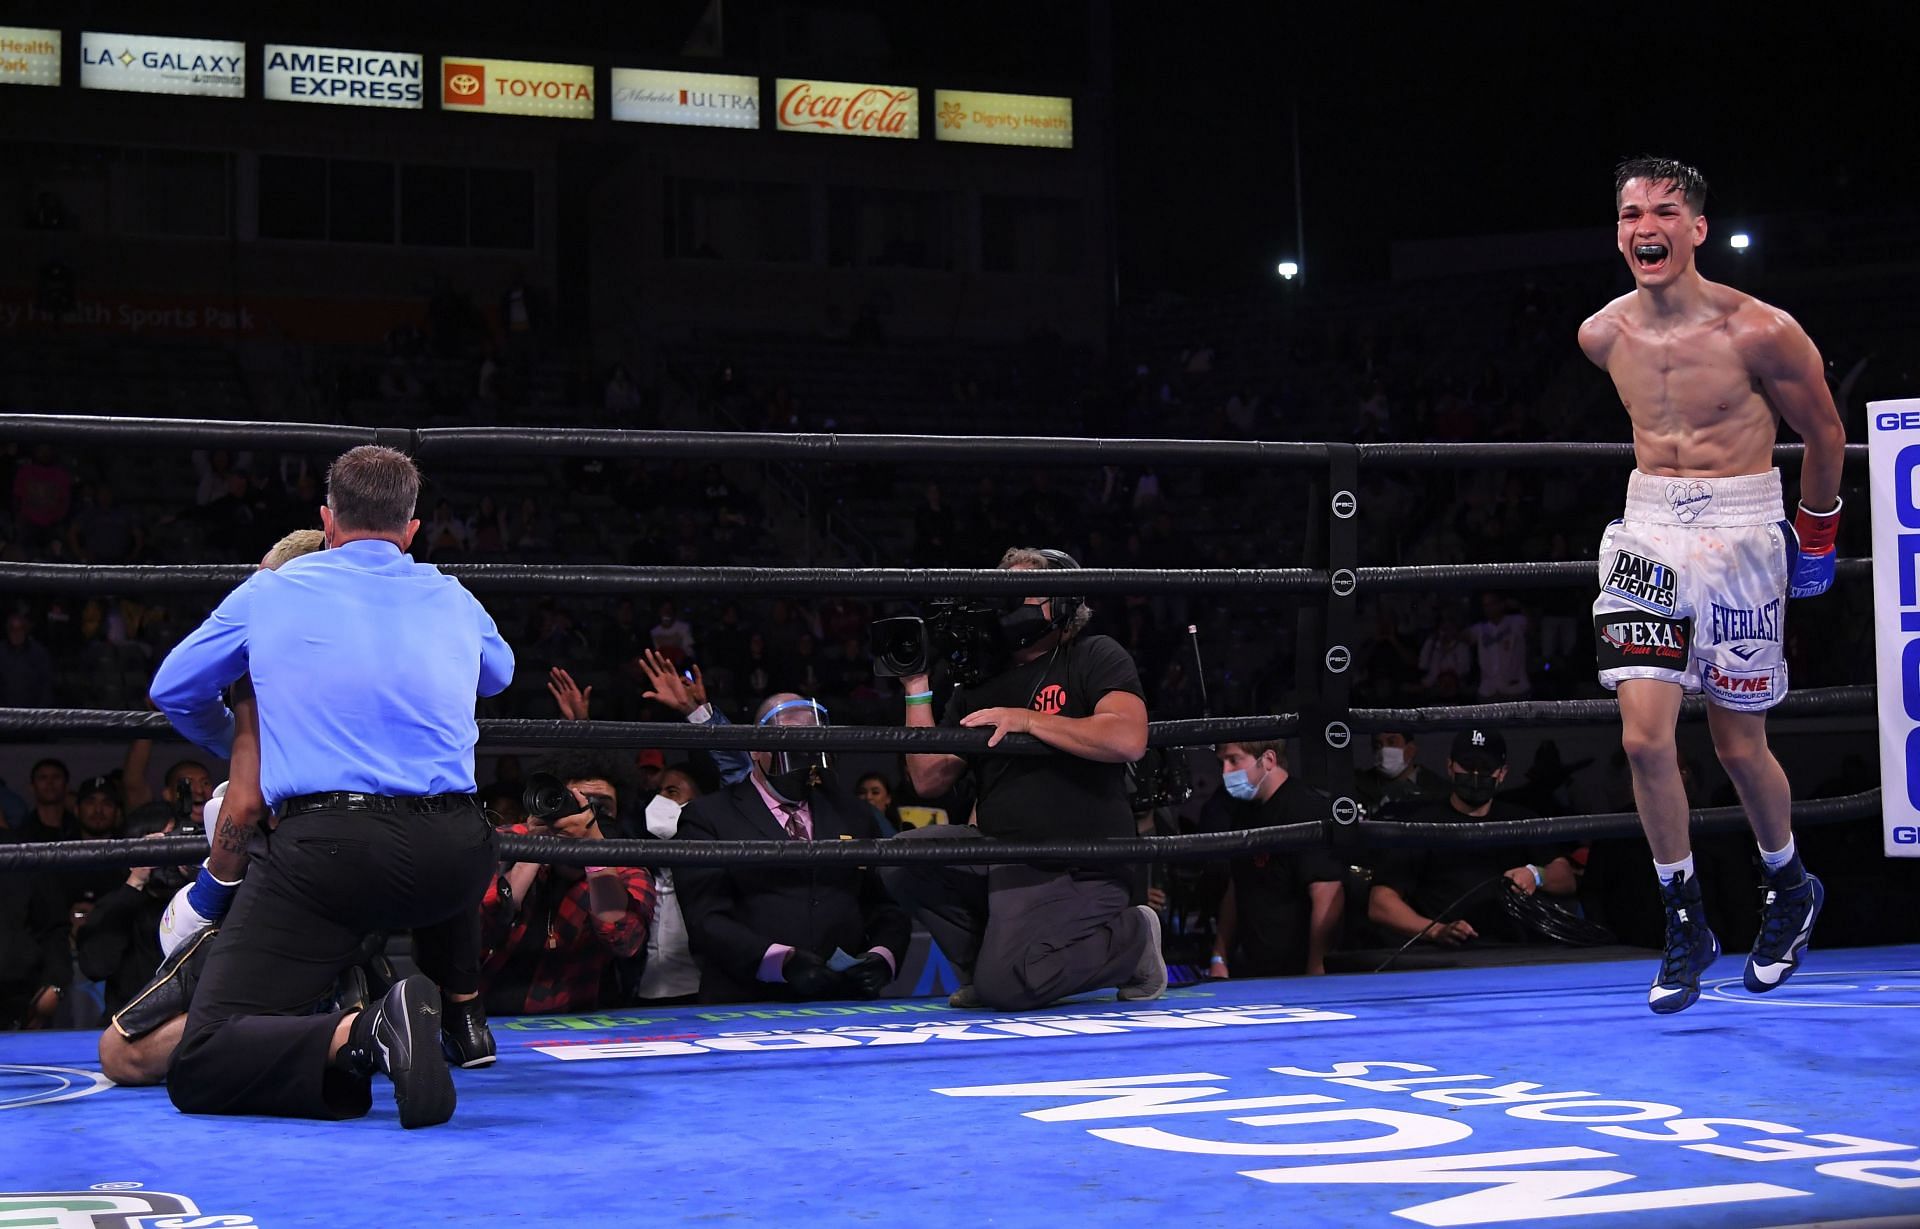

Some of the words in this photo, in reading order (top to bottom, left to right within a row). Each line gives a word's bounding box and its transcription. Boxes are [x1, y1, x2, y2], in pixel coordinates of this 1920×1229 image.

[1, 40, 55, 54] Health
[83, 48, 114, 66] LA
[142, 52, 241, 73] GALAXY
[268, 52, 419, 78] AMERICAN
[290, 77, 422, 101] EXPRESS
[495, 78, 591, 100] TOYOTA
[692, 92, 756, 111] ULTRA
[973, 111, 1021, 129] Dignity
[1024, 112, 1067, 129] Health
[119, 303, 197, 332] Sports
[205, 305, 255, 329] Park
[1607, 573, 1673, 607] FUENTES
[1711, 598, 1779, 646] EVERLAST
[1614, 622, 1684, 649] TEXAS
[1034, 688, 1067, 712] SHO
[1471, 730, 1486, 746] LA
[718, 1003, 1283, 1037] CHAMPIONSHIP
[531, 1007, 1357, 1062] BOXING
[929, 1072, 1815, 1227] MGM
